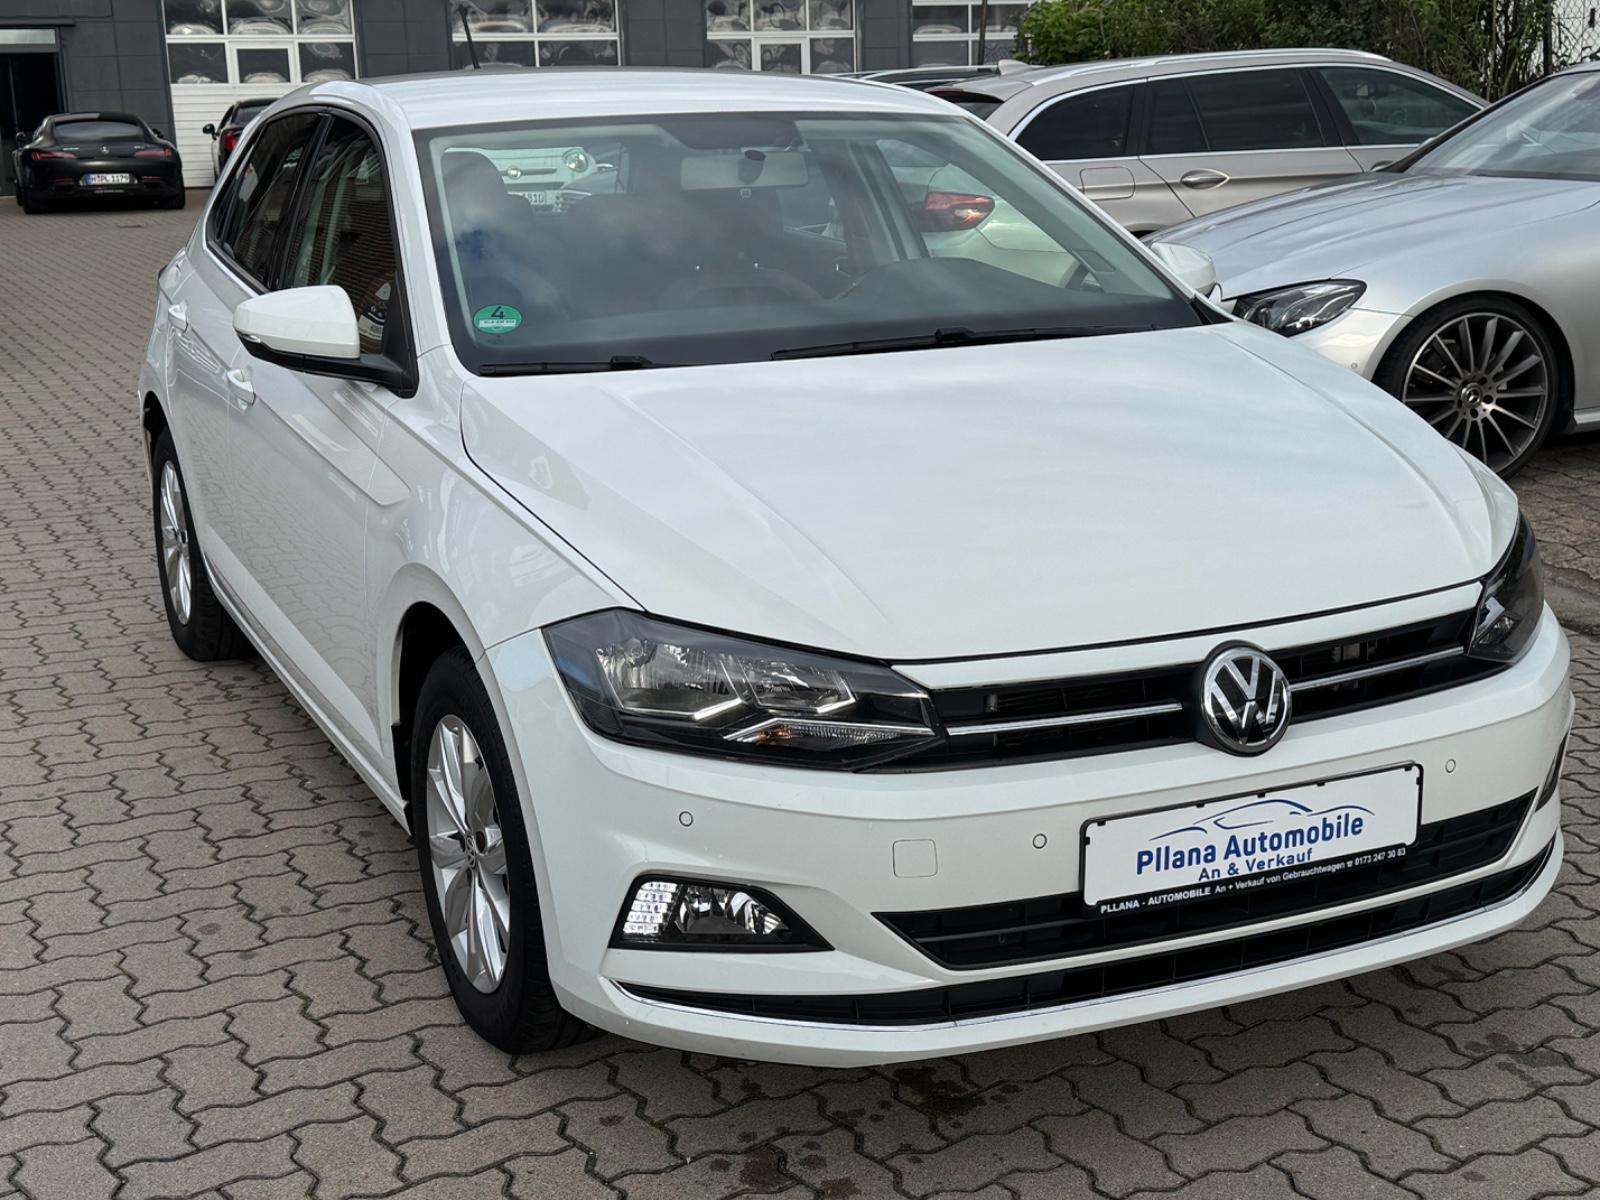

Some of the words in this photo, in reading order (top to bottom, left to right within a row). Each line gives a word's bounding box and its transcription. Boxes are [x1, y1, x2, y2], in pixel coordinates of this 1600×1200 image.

[490, 305, 505, 320] 4
[1136, 844, 1218, 875] Pllana
[1223, 812, 1365, 859] Automobile
[1198, 867, 1221, 882] An
[1227, 862, 1239, 876] &
[1246, 848, 1313, 872] Verkauf
[1100, 899, 1140, 914] PLLANA
[1147, 886, 1211, 906] AUTOMOBILE
[1214, 885, 1226, 894] An
[1235, 876, 1265, 890] Verkauf
[1266, 874, 1281, 884] von
[1282, 862, 1345, 881] Gebrauchtwagen
[1354, 855, 1372, 866] 0173
